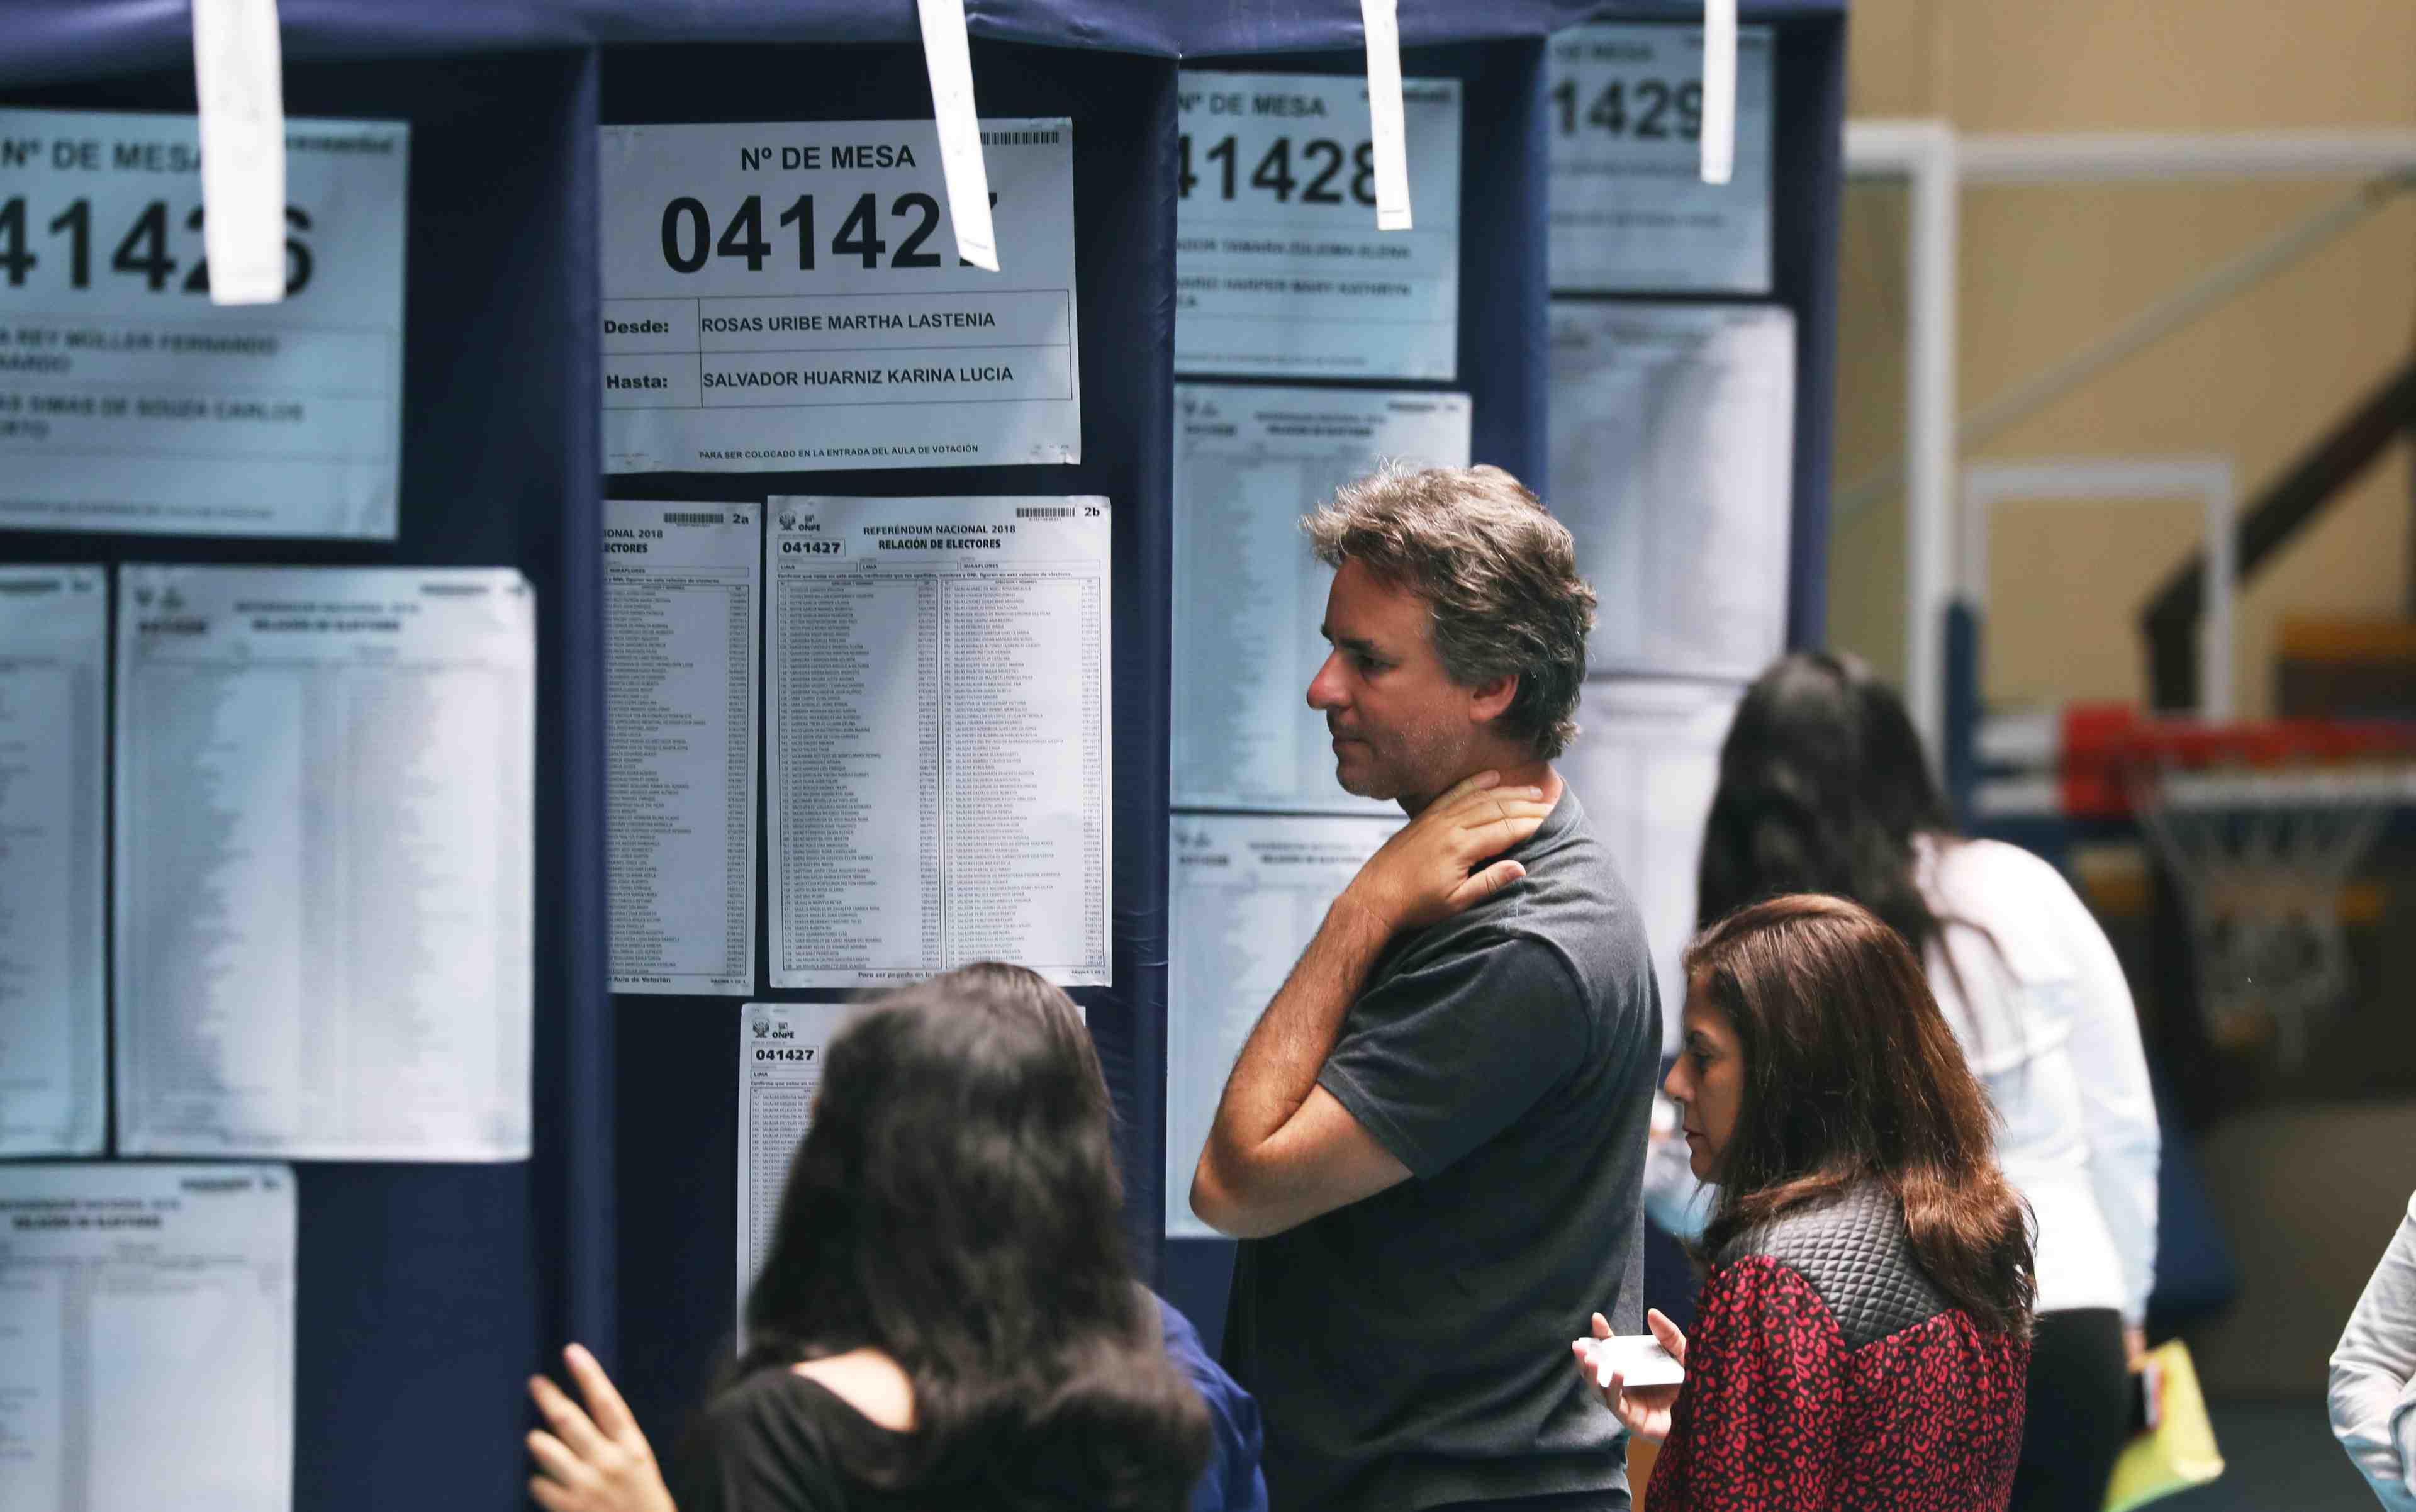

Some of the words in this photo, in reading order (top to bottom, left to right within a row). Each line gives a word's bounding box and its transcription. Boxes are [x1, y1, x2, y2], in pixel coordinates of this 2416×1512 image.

[1209, 95, 1243, 116] DE
[1252, 95, 1326, 118] MESA
[52, 142, 100, 170] DE
[781, 145, 820, 171] DE
[831, 145, 916, 170] MESA
[661, 192, 997, 273] 04142
[603, 320, 669, 334] Desde:
[701, 317, 763, 333] ROSAS
[769, 316, 822, 332] URIBE
[827, 314, 904, 330] MARTHA
[908, 313, 996, 328] LASTENIA
[606, 374, 668, 389] Hasta:
[703, 371, 798, 388] SALVADOR
[803, 369, 883, 386] HUARNIZ
[887, 367, 955, 383] KARINA
[959, 366, 1014, 382] LUCIA
[699, 451, 722, 459] PARA
[724, 451, 742, 459] SER
[744, 449, 796, 459] COLOCADO
[798, 449, 811, 457] EN
[813, 449, 825, 457] LA
[827, 447, 870, 457] ENTRADA
[871, 447, 888, 456] DEL
[891, 446, 916, 455] AULA
[918, 446, 930, 454] DE
[932, 444, 978, 454] VOTACIÓN
[732, 513, 749, 524] 2a
[1083, 507, 1100, 517] 2b
[638, 529, 664, 539] 2018
[863, 524, 933, 535] REFERÉNDUM
[936, 524, 988, 534] NACIONAL
[991, 524, 1016, 534] 2018
[782, 541, 841, 554] 041427
[878, 537, 927, 549] RELACIÓN
[930, 539, 944, 549] DE
[946, 539, 1002, 549] ELECTORES
[755, 1049, 814, 1061] 041427
